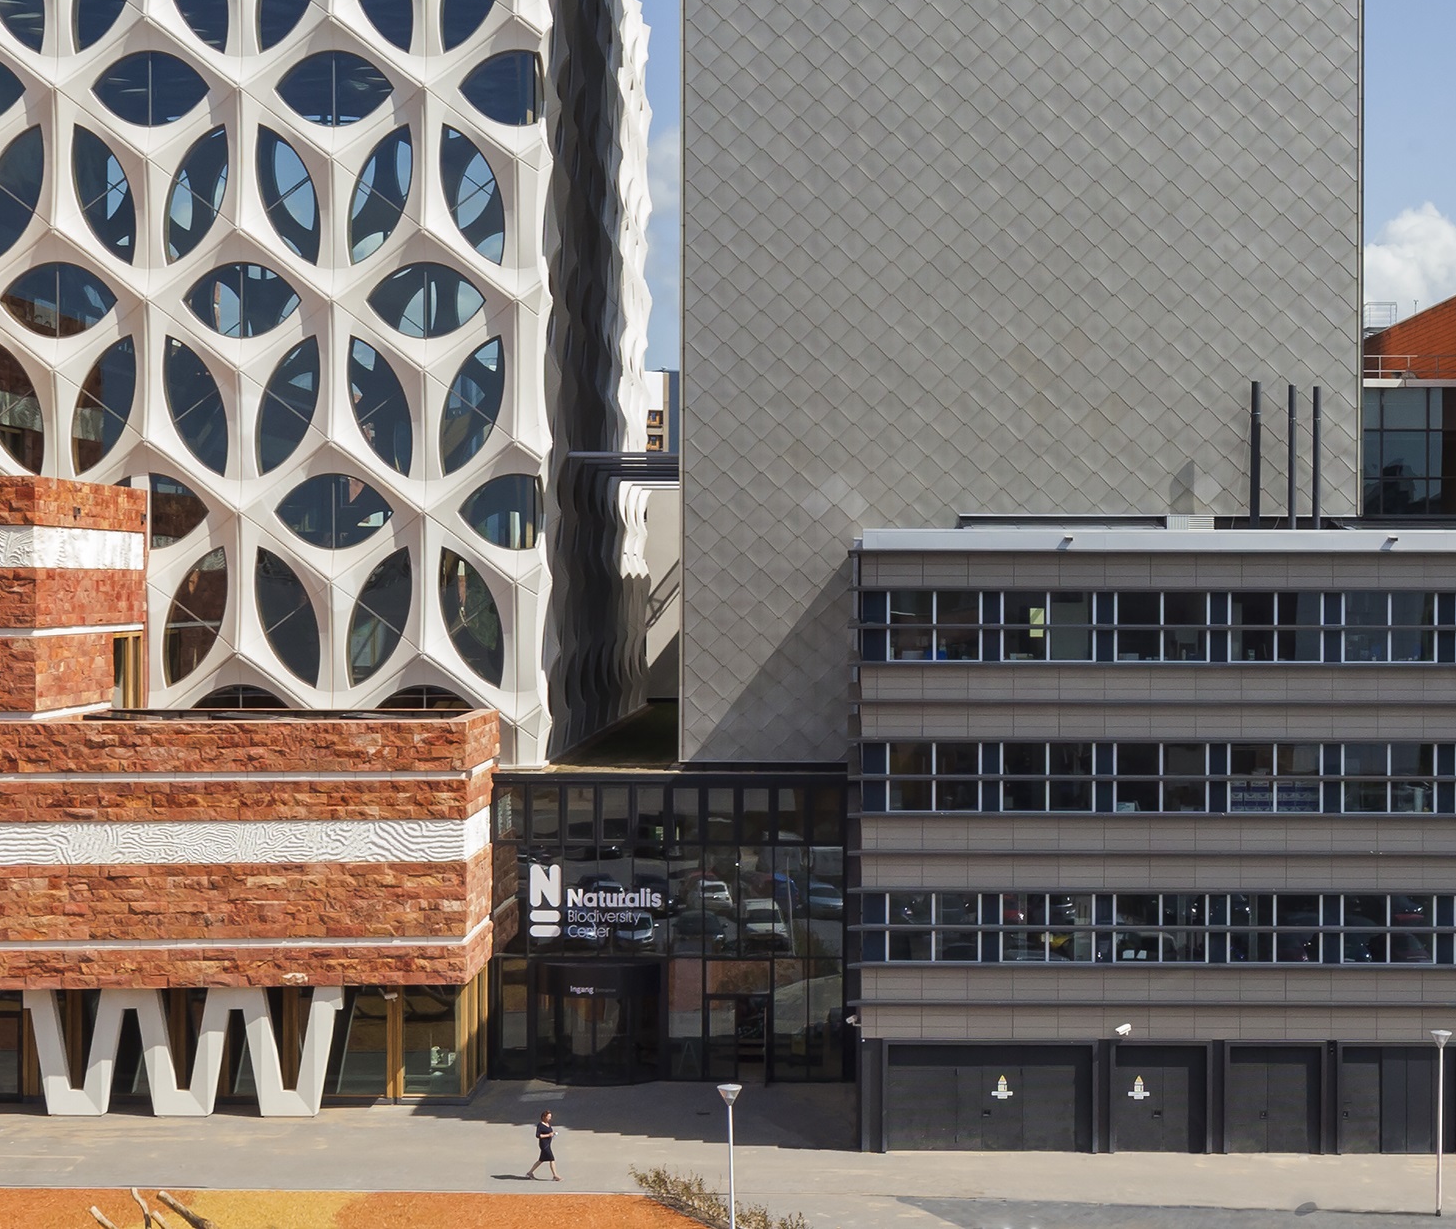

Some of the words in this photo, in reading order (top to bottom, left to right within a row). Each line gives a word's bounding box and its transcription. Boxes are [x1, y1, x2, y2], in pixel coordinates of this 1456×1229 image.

[567, 888, 662, 908] Naturalis
[567, 910, 641, 925] Biodiversity
[567, 924, 610, 938] Center
[570, 985, 594, 994] Ingang
